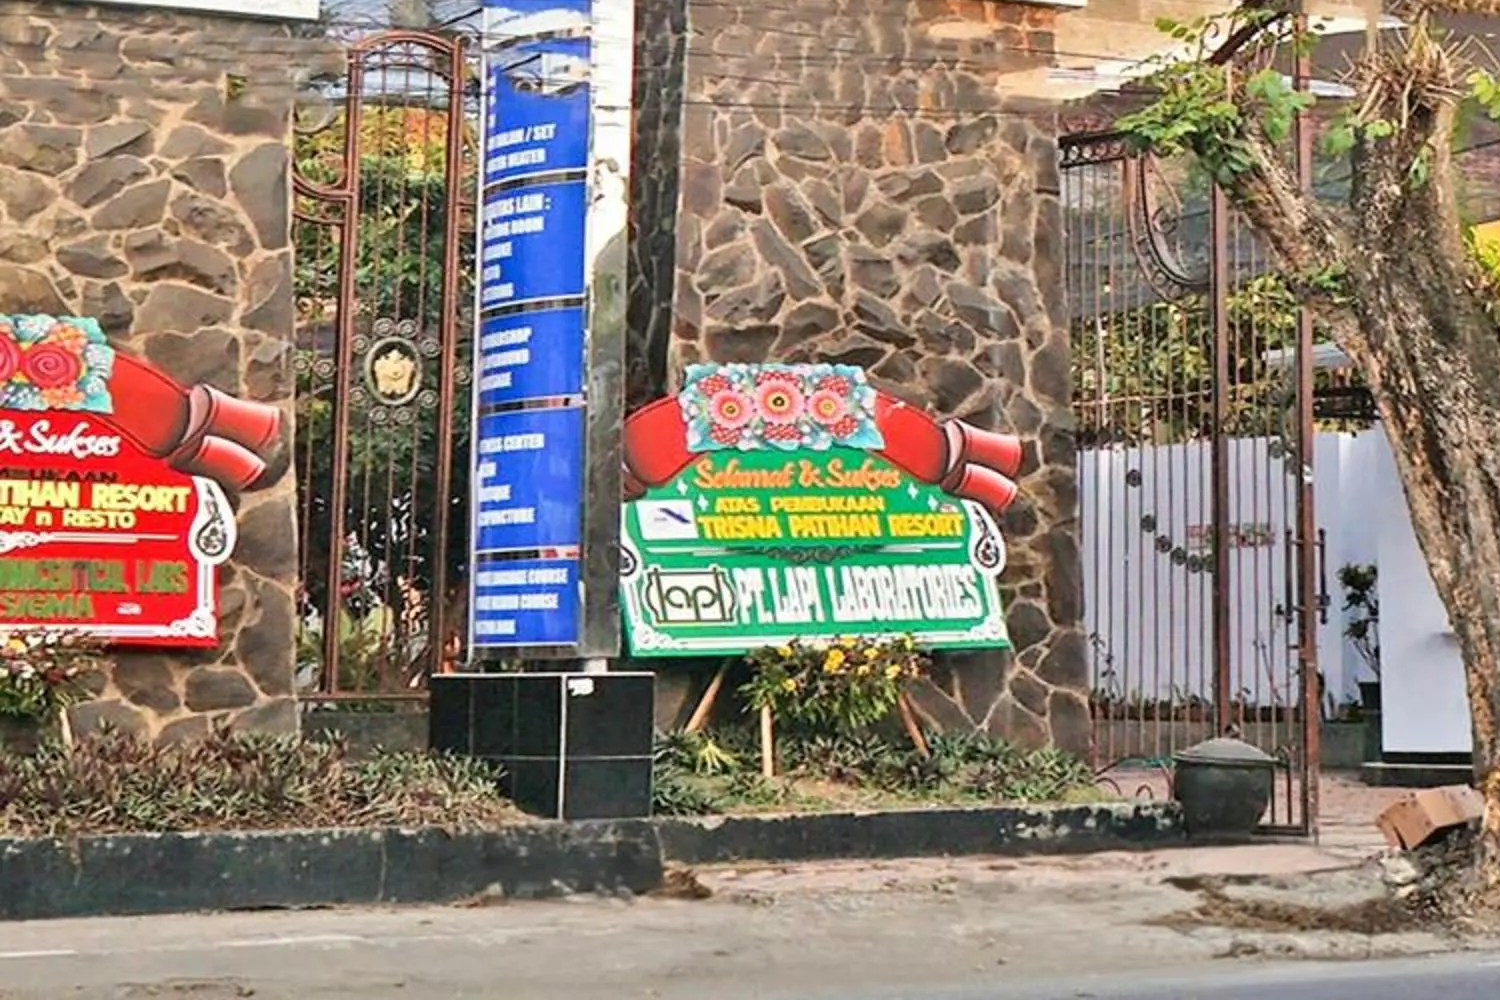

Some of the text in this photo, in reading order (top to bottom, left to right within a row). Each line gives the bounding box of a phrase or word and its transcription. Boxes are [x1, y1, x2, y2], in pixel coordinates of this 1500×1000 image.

[24, 419, 122, 459] Sukses
[694, 458, 901, 491] Selamat & Sukses
[91, 482, 191, 513] RESORT
[715, 496, 885, 514] ATAS PEMBUKAAN
[35, 511, 52, 527] n
[62, 509, 137, 529] RESTO
[698, 512, 964, 540] TRISNA PATIHAN RESORT
[768, 566, 826, 623] LAPI
[826, 564, 986, 623] LABORATORIES
